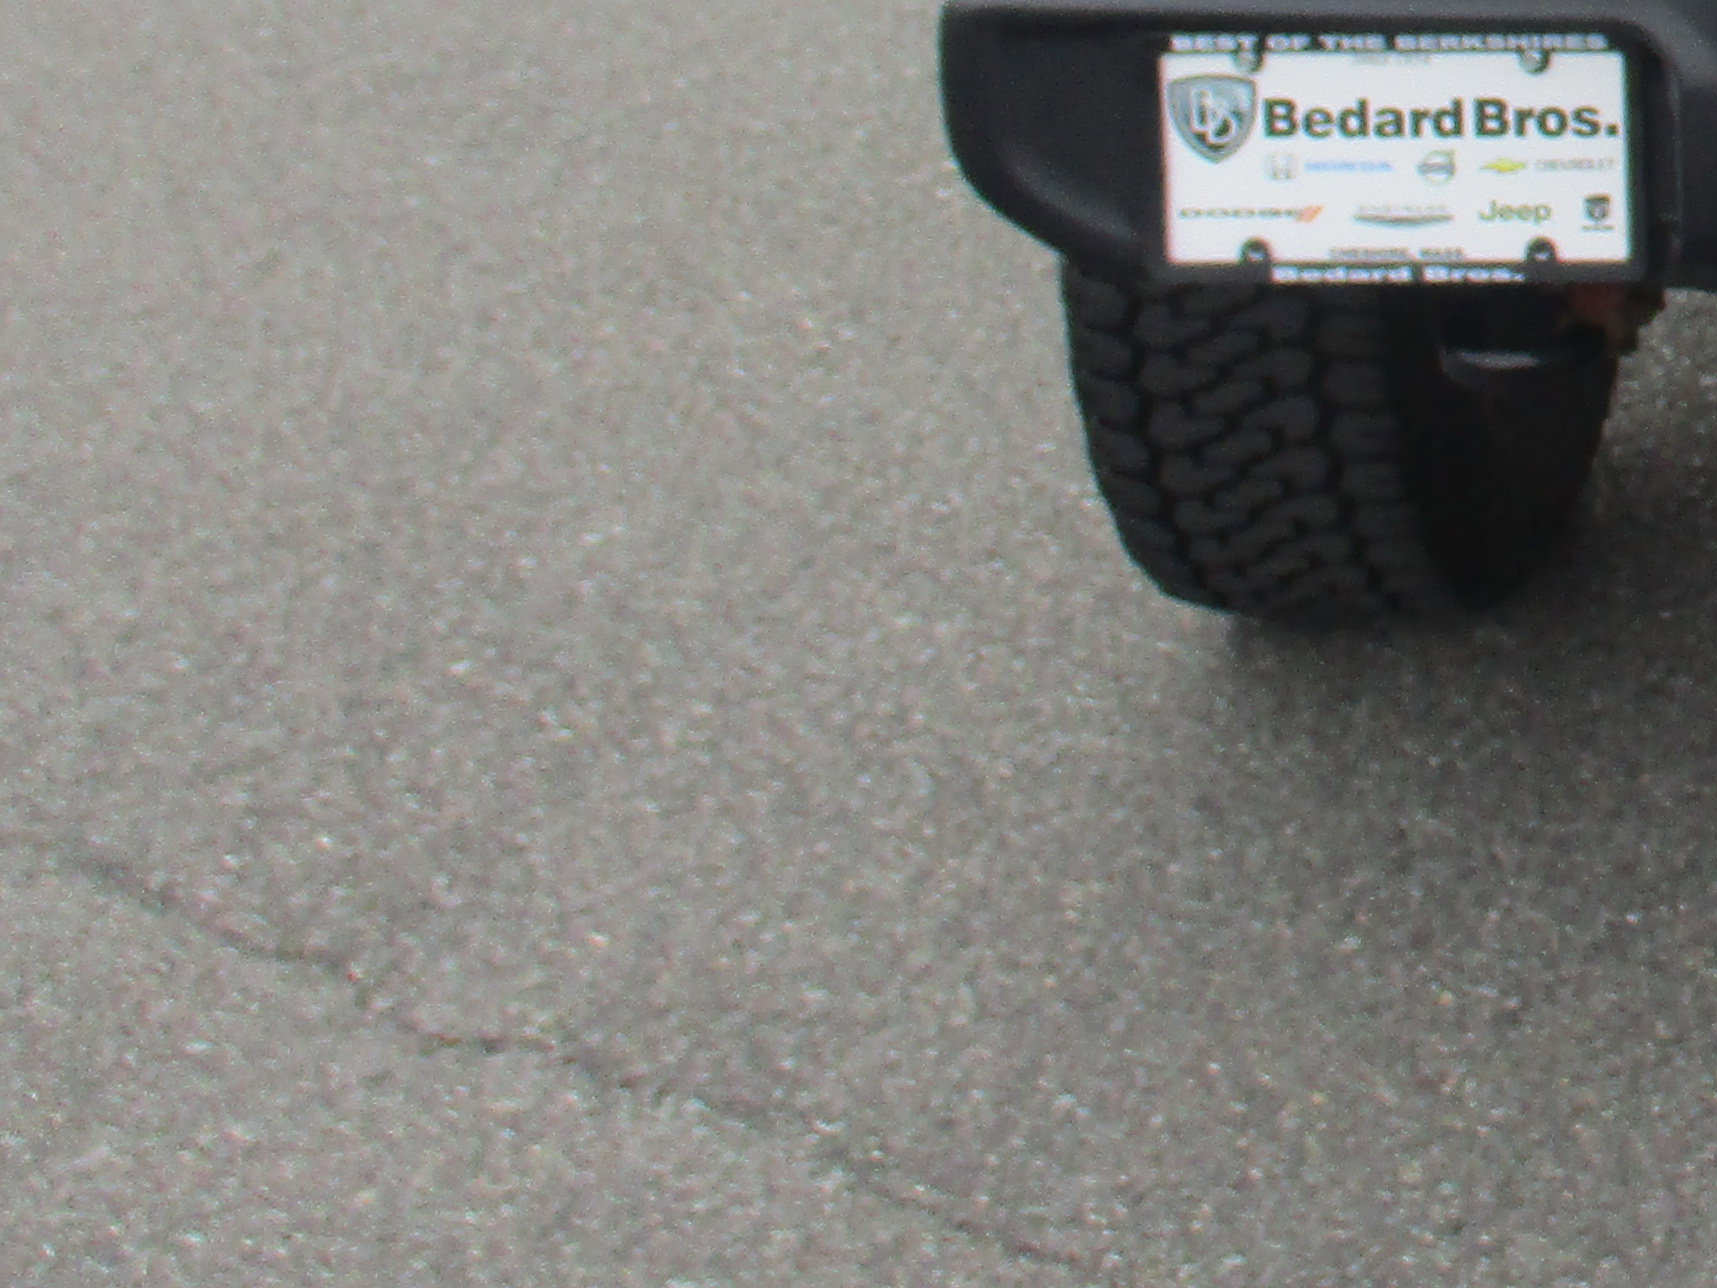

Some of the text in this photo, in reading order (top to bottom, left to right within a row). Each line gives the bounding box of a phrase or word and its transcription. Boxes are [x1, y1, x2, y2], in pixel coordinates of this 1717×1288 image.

[1169, 33, 1258, 52] BEST
[1264, 33, 1312, 52] OF
[1316, 33, 1387, 52] THE
[1263, 96, 1463, 137] Bedard
[1474, 96, 1619, 137] Bros.
[1478, 199, 1553, 225] Jeep
[1271, 266, 1526, 284] Bedard Bros.
